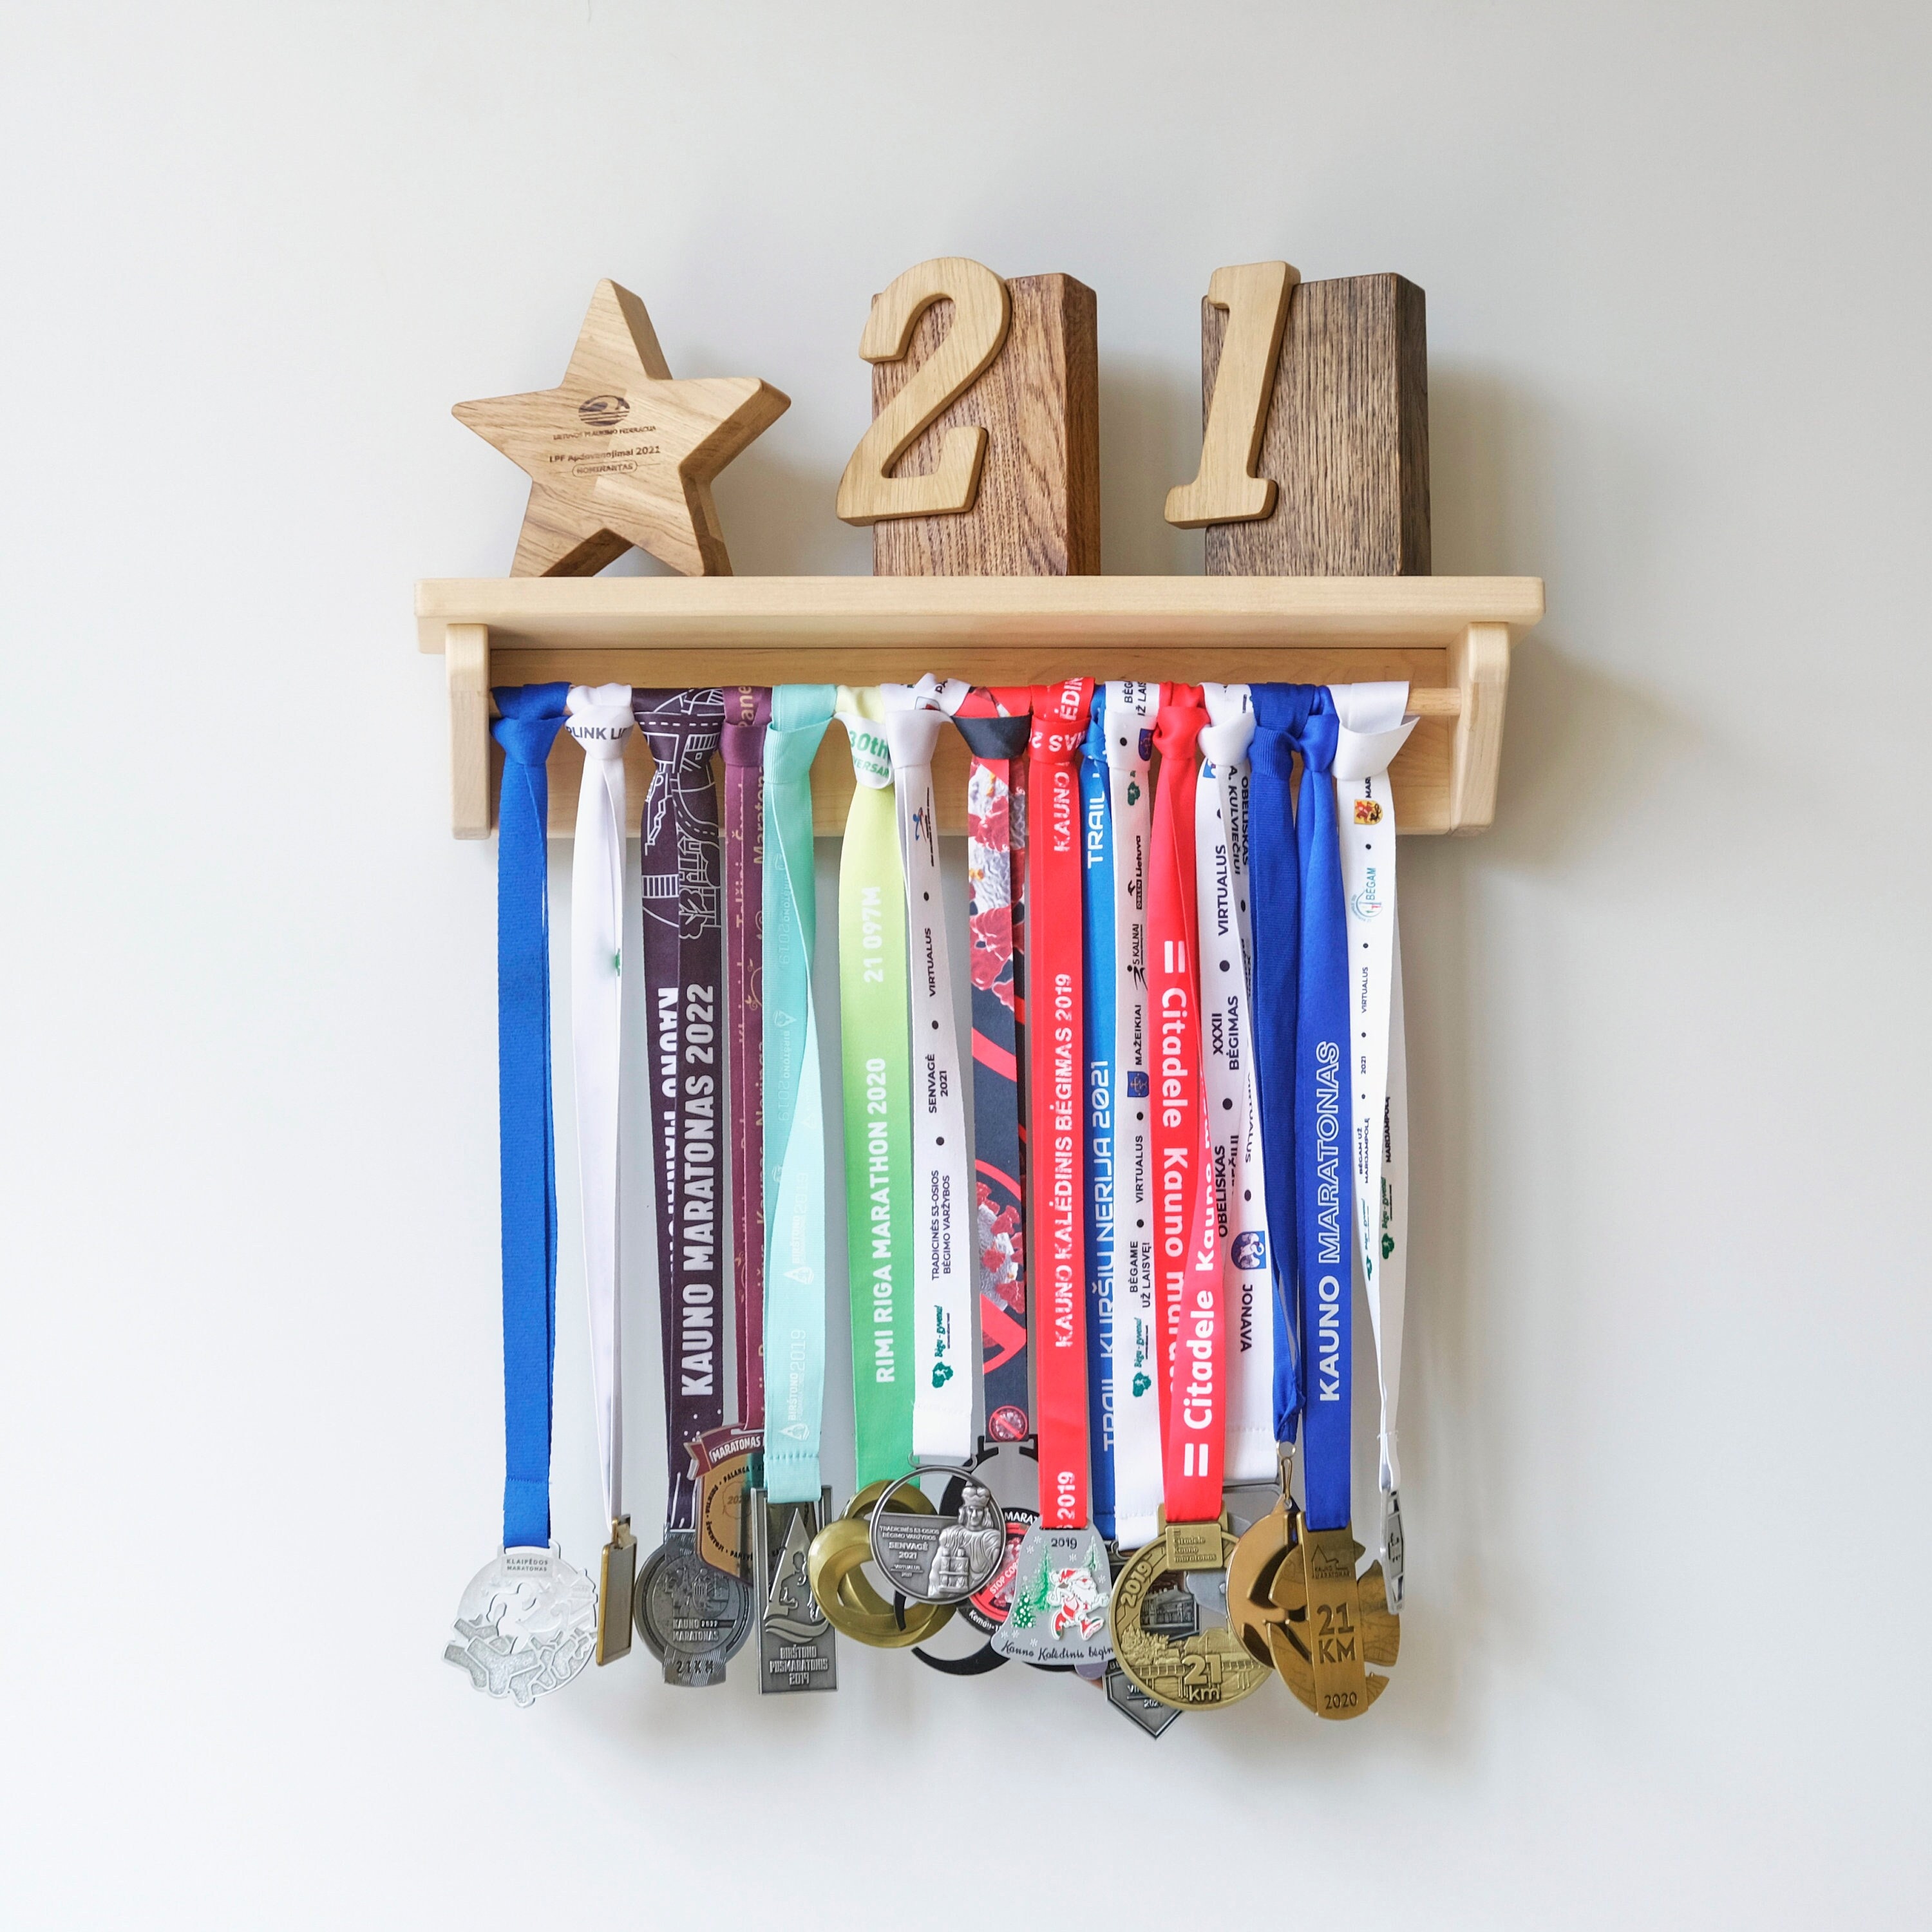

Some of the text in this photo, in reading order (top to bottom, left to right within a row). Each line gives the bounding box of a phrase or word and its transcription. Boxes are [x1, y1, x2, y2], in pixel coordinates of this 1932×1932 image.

[835, 256, 1300, 529] 2 1
[636, 445, 661, 455] 2021
[1054, 772, 1071, 853] KAUNO
[1086, 790, 1106, 869] TRAIL
[1215, 844, 1229, 936] VIRTUALUS
[924, 927, 936, 997] VIRTUALUS
[1132, 923, 1140, 957] KALNAI
[864, 958, 884, 983] 21
[1133, 1005, 1142, 1065] MAŽEIKIAI
[1161, 987, 1188, 1128] Citadele
[1211, 1013, 1223, 1056] XXXII
[1226, 996, 1240, 1070] BĖGIMAS
[925, 1054, 938, 1113] SENVAGĖ
[1090, 1060, 1110, 1129] 2021
[1048, 973, 1074, 1348] KAUNO KALĖDINIS BĖGIMAS 2019
[1135, 1135, 1144, 1203] VIRTUALUS
[681, 983, 714, 1396] KAUNO MARATONAS 2022
[1162, 1147, 1188, 1258] Kauno
[1215, 1145, 1228, 1238] OBELISKAS
[866, 1057, 895, 1383] RIMI RIGA MARATHON 2020
[941, 1175, 951, 1274] BĖGIMO VARŽYBOS
[1316, 1041, 1340, 1402] KAUNO MARATONAS
[931, 1216, 940, 1281] TRADICINĖS
[1129, 1241, 1139, 1293] BĖGAME
[1139, 1293, 1151, 1308] UŽ
[1240, 1283, 1253, 1352] JONAVA
[790, 1329, 806, 1371] 2019
[1183, 1289, 1215, 1430] Citadele
[710, 1436, 761, 1464] MARATONAS
[1057, 1471, 1076, 1520] 2019
[889, 1541, 929, 1551] SENVAGĖ
[898, 1551, 917, 1559] 2021
[1051, 1537, 1077, 1549] 2019
[989, 1576, 1006, 1595] STOP
[1120, 1560, 1153, 1609] 2019
[672, 1618, 700, 1630] KAUNO
[672, 1631, 719, 1642] MARATONAS
[1317, 1602, 1354, 1636] 21
[780, 1643, 817, 1660] BIRŠTONO
[1001, 1640, 1034, 1657] Kauno
[1183, 1654, 1222, 1685] 21
[1319, 1636, 1356, 1663] KM
[789, 1672, 810, 1685] 2019
[1189, 1683, 1222, 1702] km
[1324, 1691, 1358, 1710] 2020
